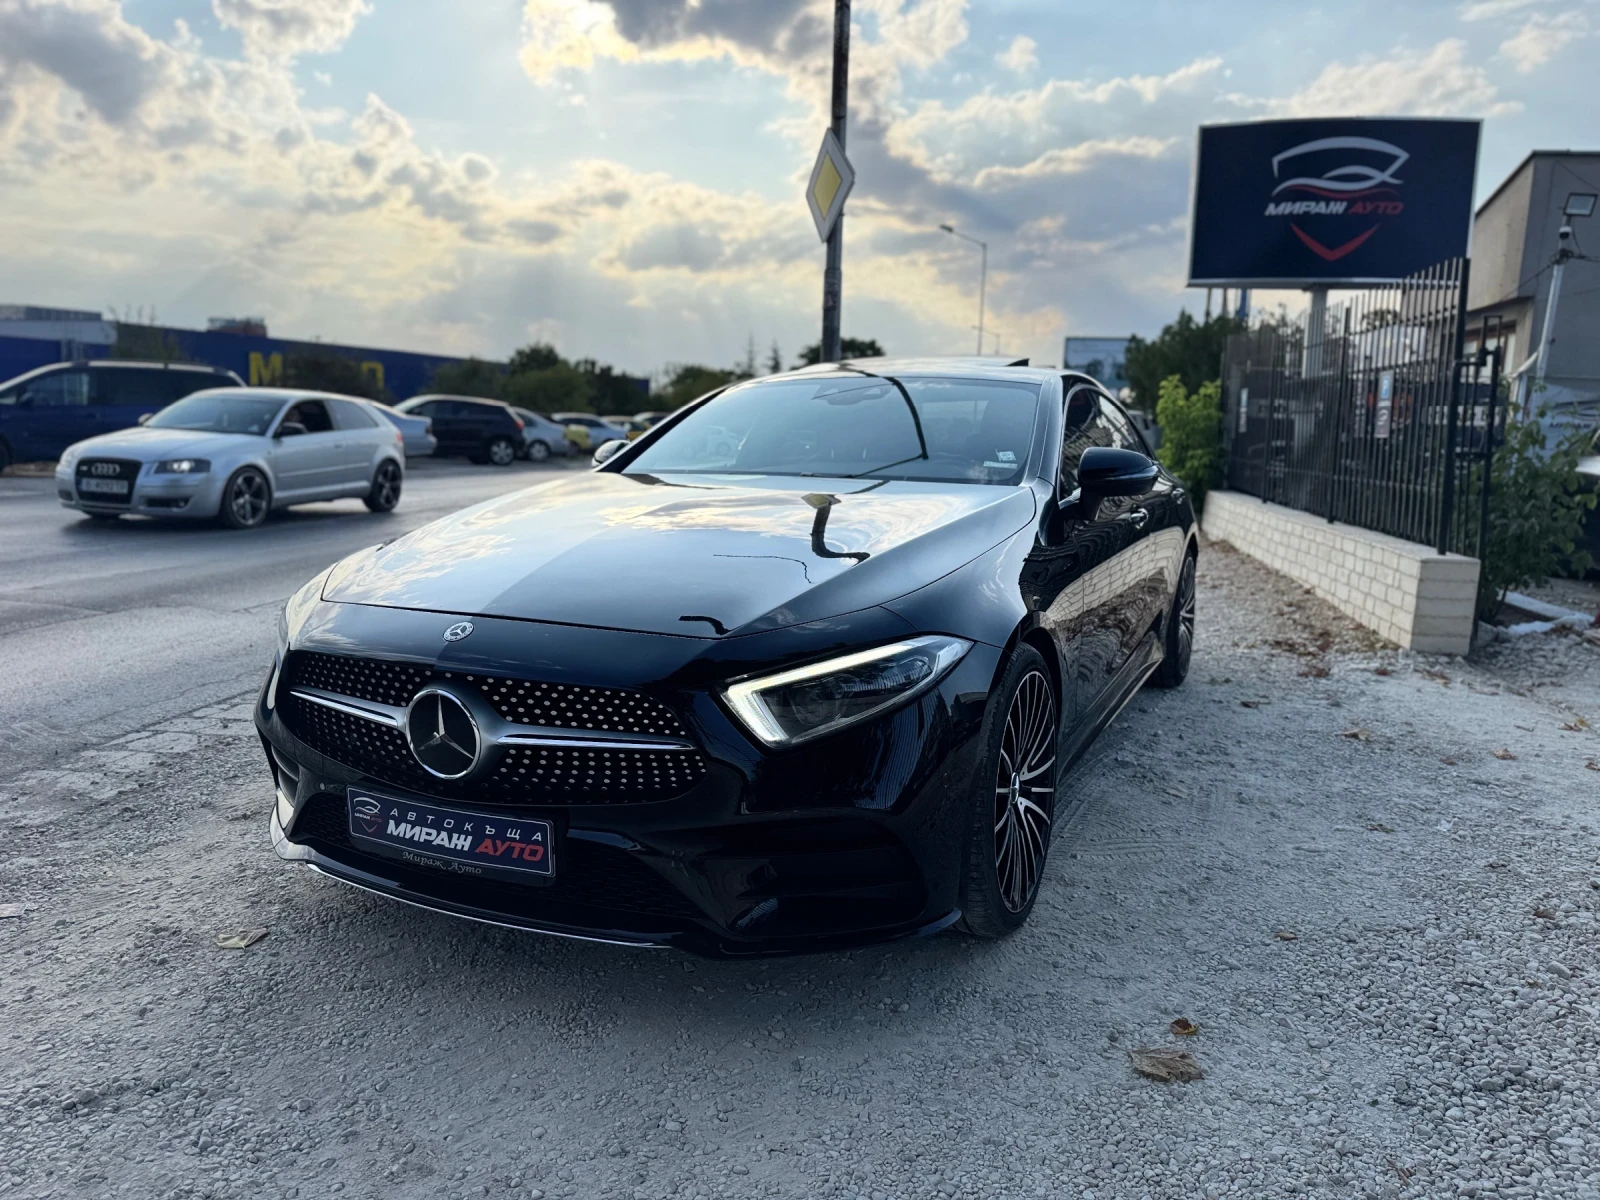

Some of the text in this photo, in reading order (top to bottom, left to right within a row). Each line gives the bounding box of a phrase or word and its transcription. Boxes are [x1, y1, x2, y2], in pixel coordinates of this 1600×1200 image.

[1264, 201, 1404, 216] МИРАЖ АУТО
[386, 819, 544, 862] МИРАЖ АУТО
[390, 808, 542, 841] АВТОКЪЩА
